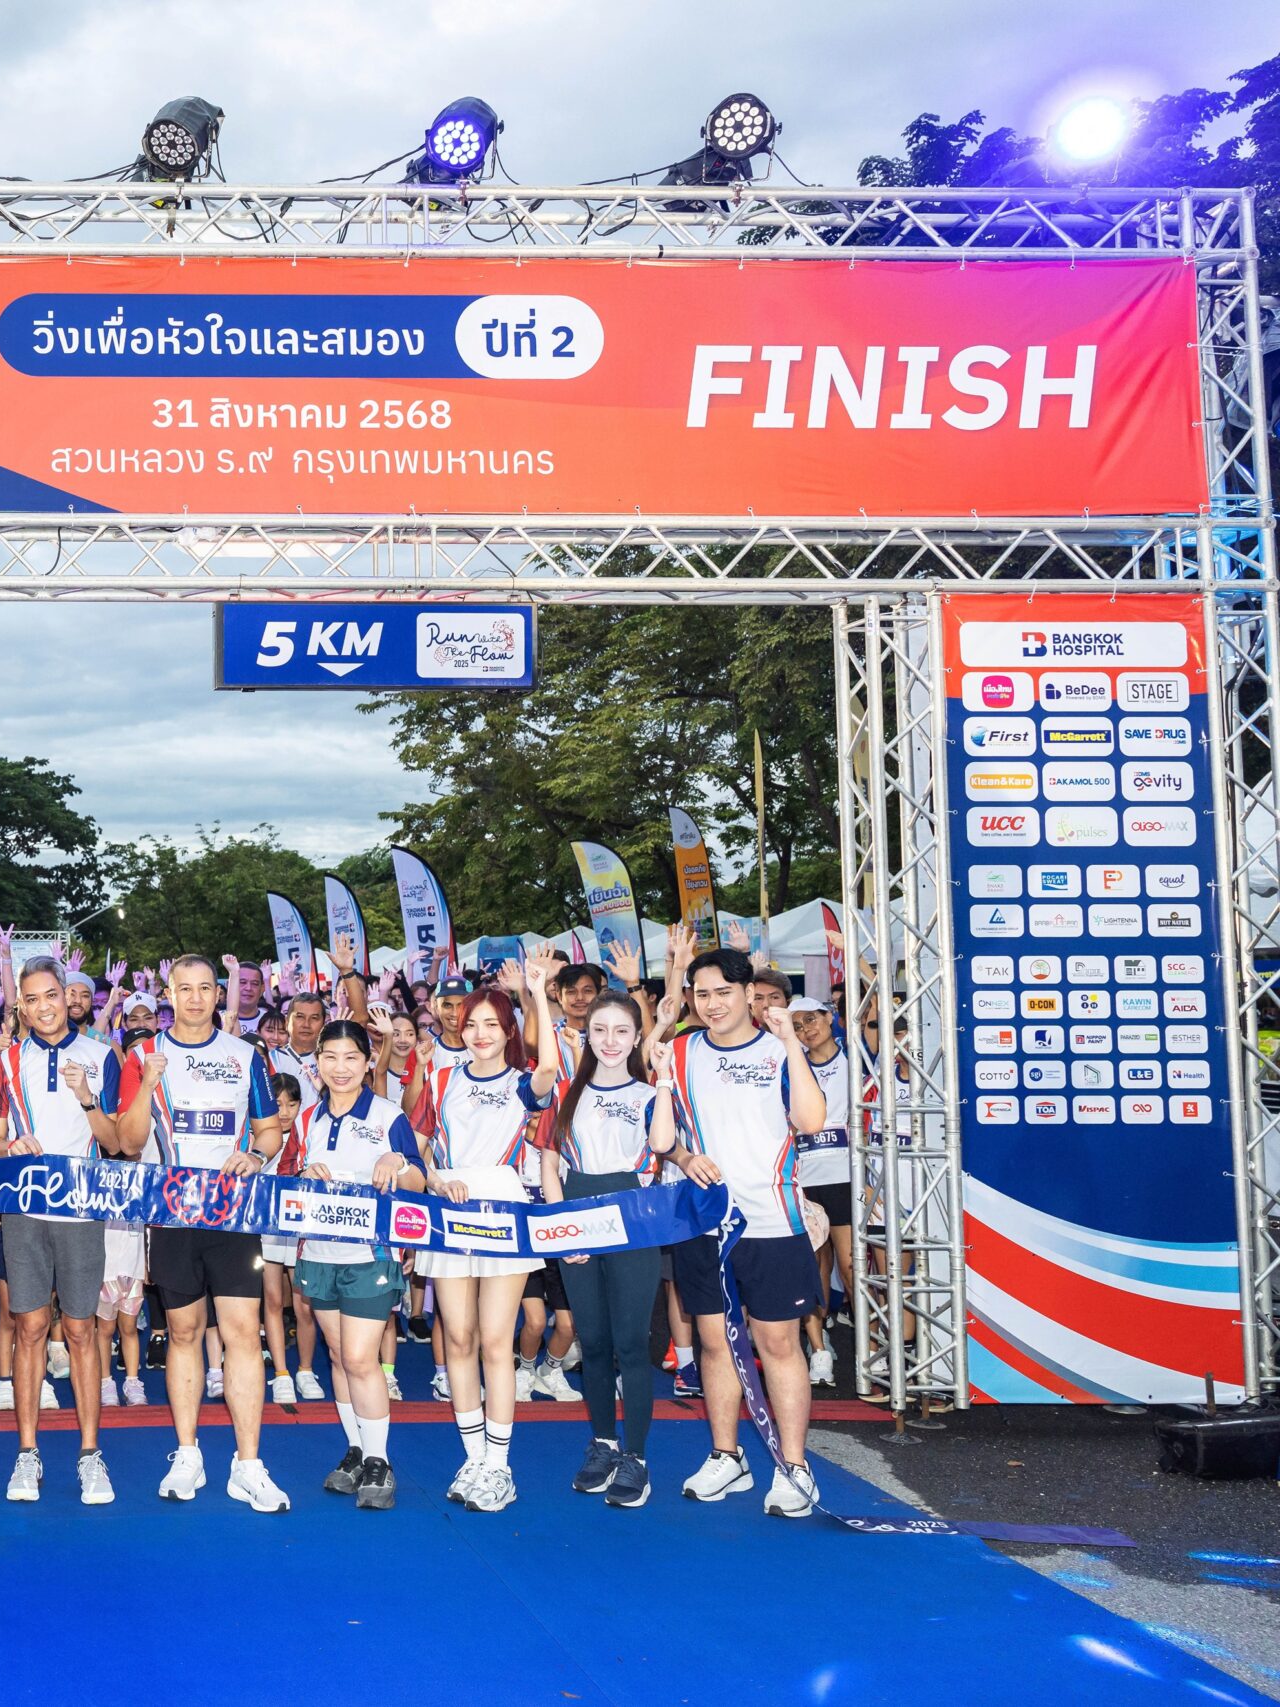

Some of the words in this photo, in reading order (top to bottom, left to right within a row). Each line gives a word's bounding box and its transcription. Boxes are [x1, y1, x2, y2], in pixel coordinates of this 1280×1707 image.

[32, 310, 426, 357] วิ่งเพื่อหัวใจและสมอง
[481, 309, 538, 359] ปีที่
[551, 326, 576, 358] 2
[686, 345, 1098, 431] FINISH
[152, 399, 199, 428] 31
[209, 396, 347, 429] สิงหาคม
[359, 400, 452, 429] 2568
[51, 445, 205, 475] สวนหลวง
[216, 445, 274, 475] ร.๙
[293, 445, 554, 484] กรุงเทพมหานคร
[426, 622, 476, 647] Run
[1052, 633, 1124, 644] BANGKOK
[256, 621, 296, 667] 5
[307, 622, 384, 656] KM
[1052, 644, 1125, 656] HOSPITAL
[470, 646, 514, 663] Flow
[1065, 685, 1106, 695] BeDee
[1131, 683, 1173, 699] STAGE
[988, 731, 1029, 741] First
[1049, 732, 1106, 741] McGarrett
[1124, 729, 1152, 739] SAVE
[1155, 729, 1186, 739] DRUG
[971, 777, 1032, 786] Klean&Kare
[1094, 777, 1110, 785] 500
[1159, 874, 1185, 888] equal
[985, 967, 1009, 976] TAK
[1029, 1000, 1054, 1009] O-CON
[185, 1055, 218, 1071] Run
[716, 1057, 751, 1072] Run
[1129, 1070, 1152, 1079] L&E
[593, 1096, 622, 1109] Run
[196, 1113, 224, 1128] 5109
[814, 1131, 838, 1144] 5675
[312, 1204, 370, 1218] ANGKOK
[453, 1223, 508, 1238] McGarrett
[908, 1519, 950, 1530] 2025
